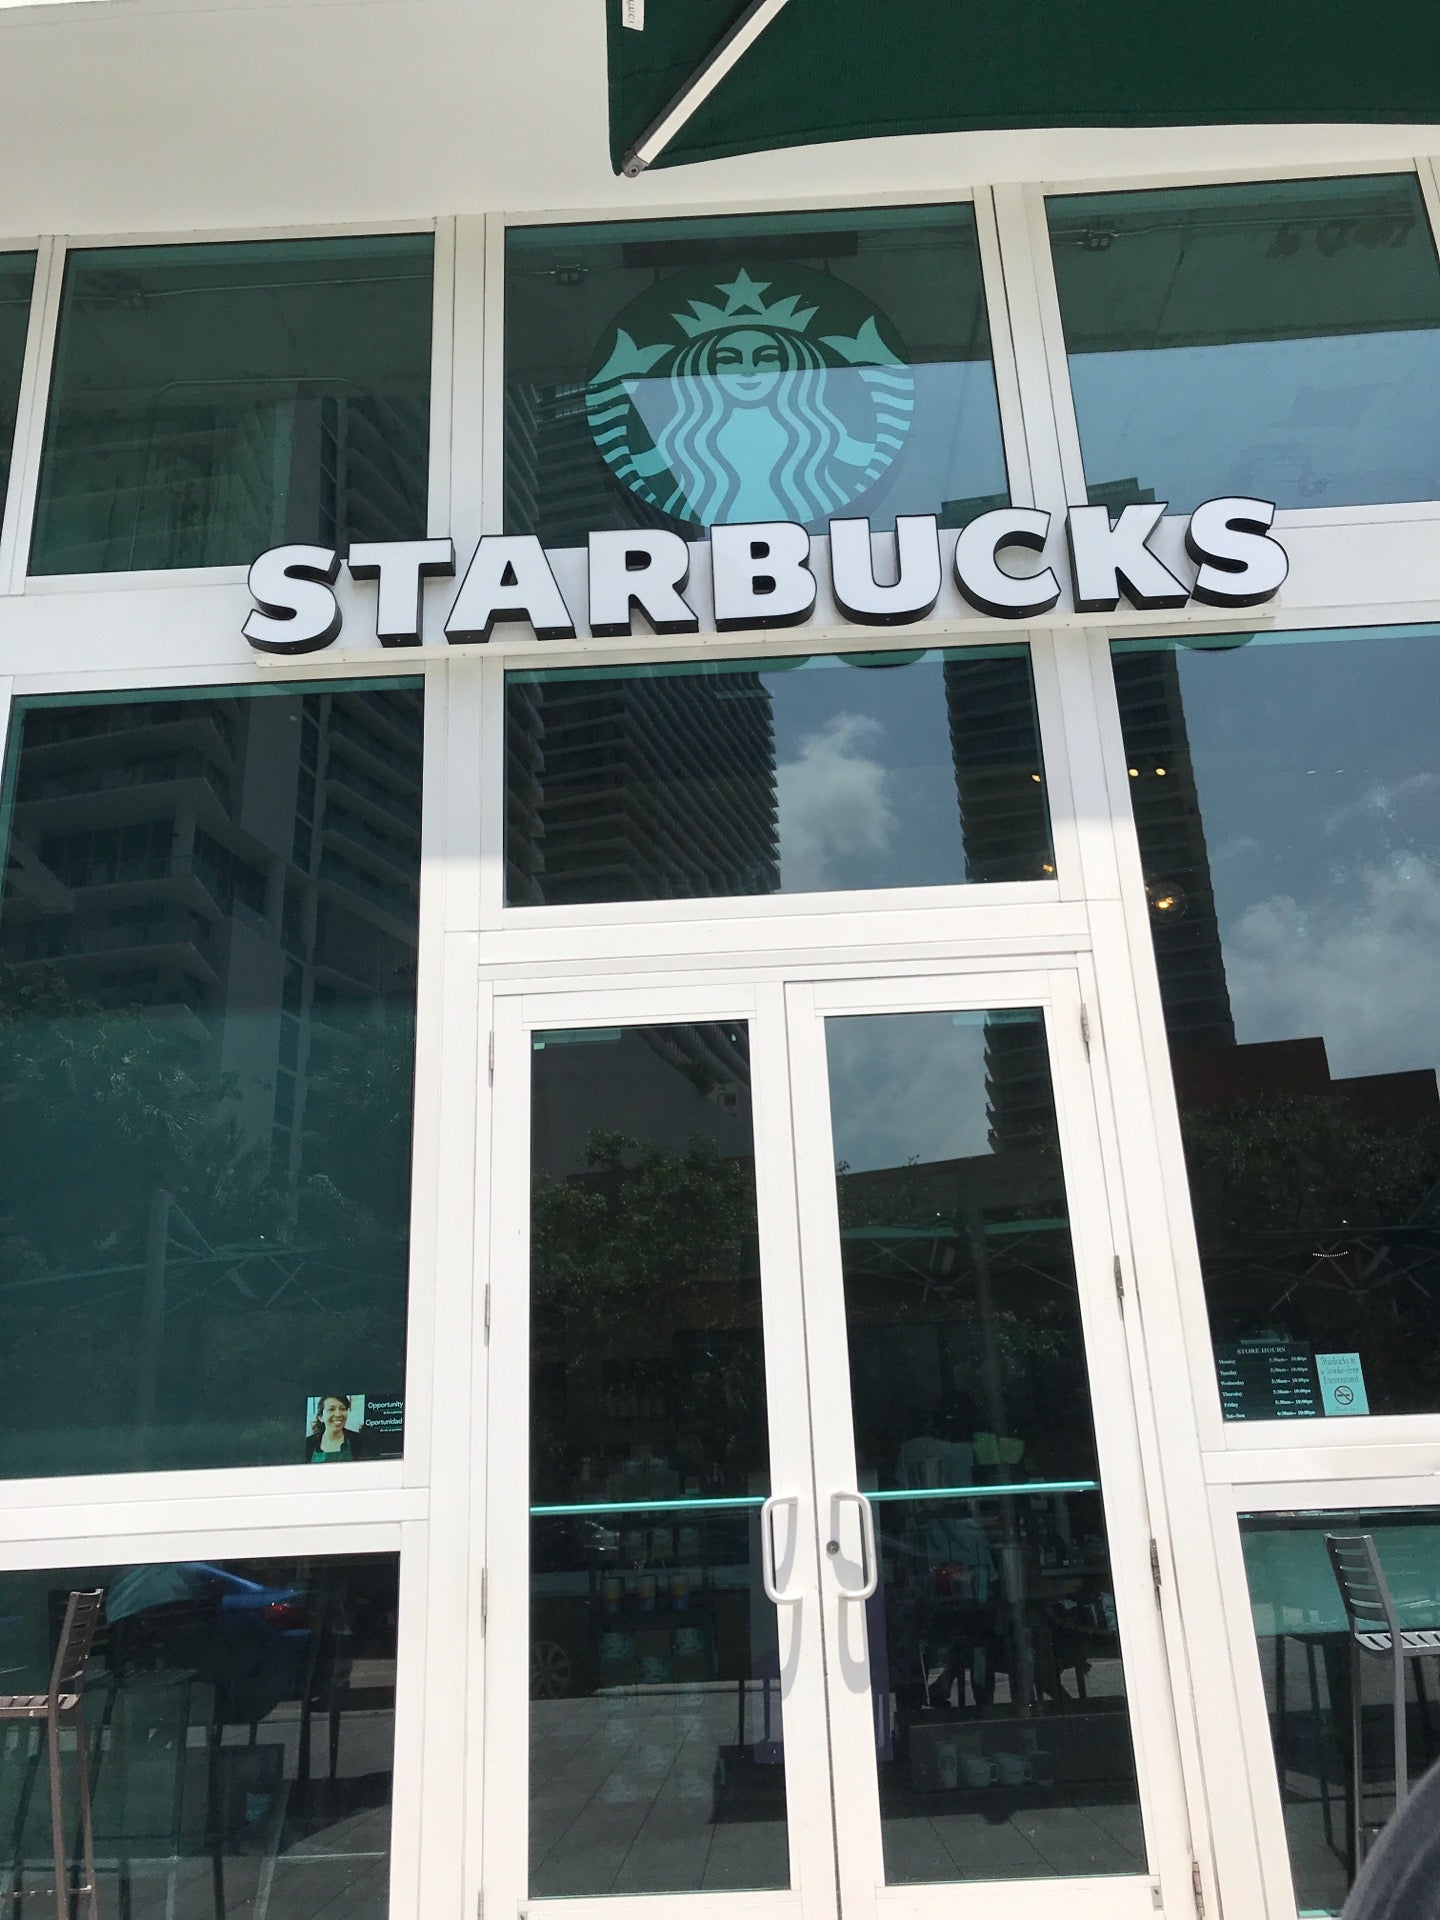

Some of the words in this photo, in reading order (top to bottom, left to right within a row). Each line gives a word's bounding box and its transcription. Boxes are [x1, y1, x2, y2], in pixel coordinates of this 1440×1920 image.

[242, 496, 1290, 655] STARBUCKS
[367, 1401, 404, 1410] Opportunity
[365, 1417, 403, 1426] Oportunidad
